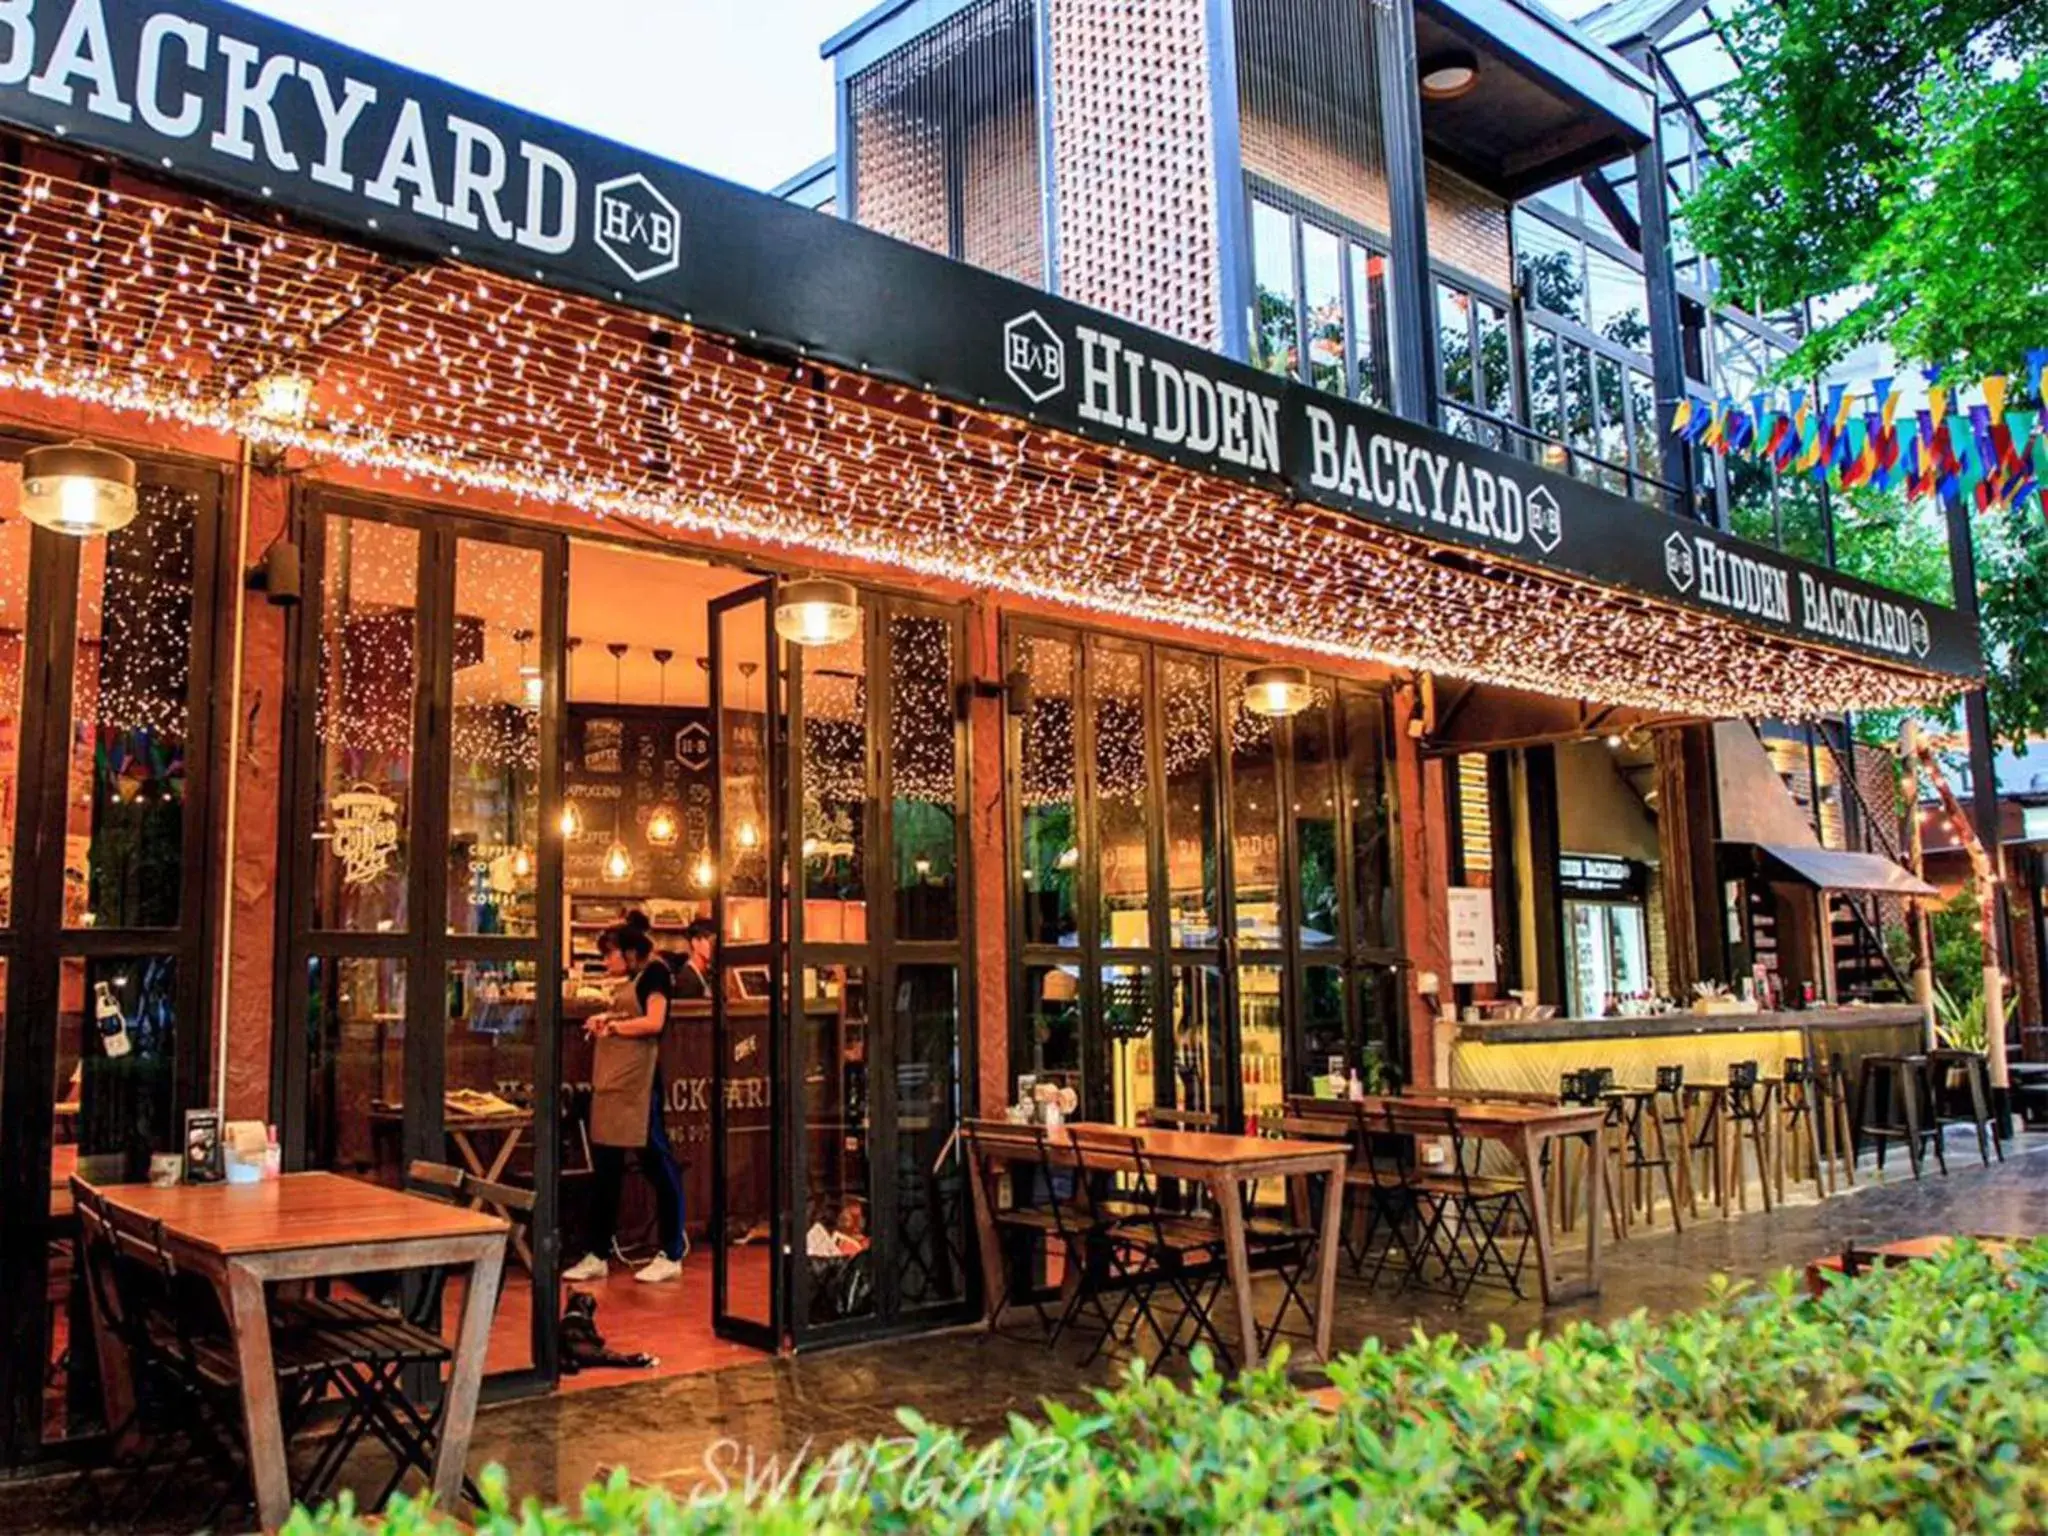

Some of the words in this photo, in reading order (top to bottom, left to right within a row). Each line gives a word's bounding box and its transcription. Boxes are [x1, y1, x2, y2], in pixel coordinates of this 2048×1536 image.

[1076, 325, 1280, 474] HIDDEN
[1305, 404, 1524, 544] BACKYARD
[1694, 537, 1791, 623] HIDDEN
[1799, 572, 1911, 654] BACKYARD
